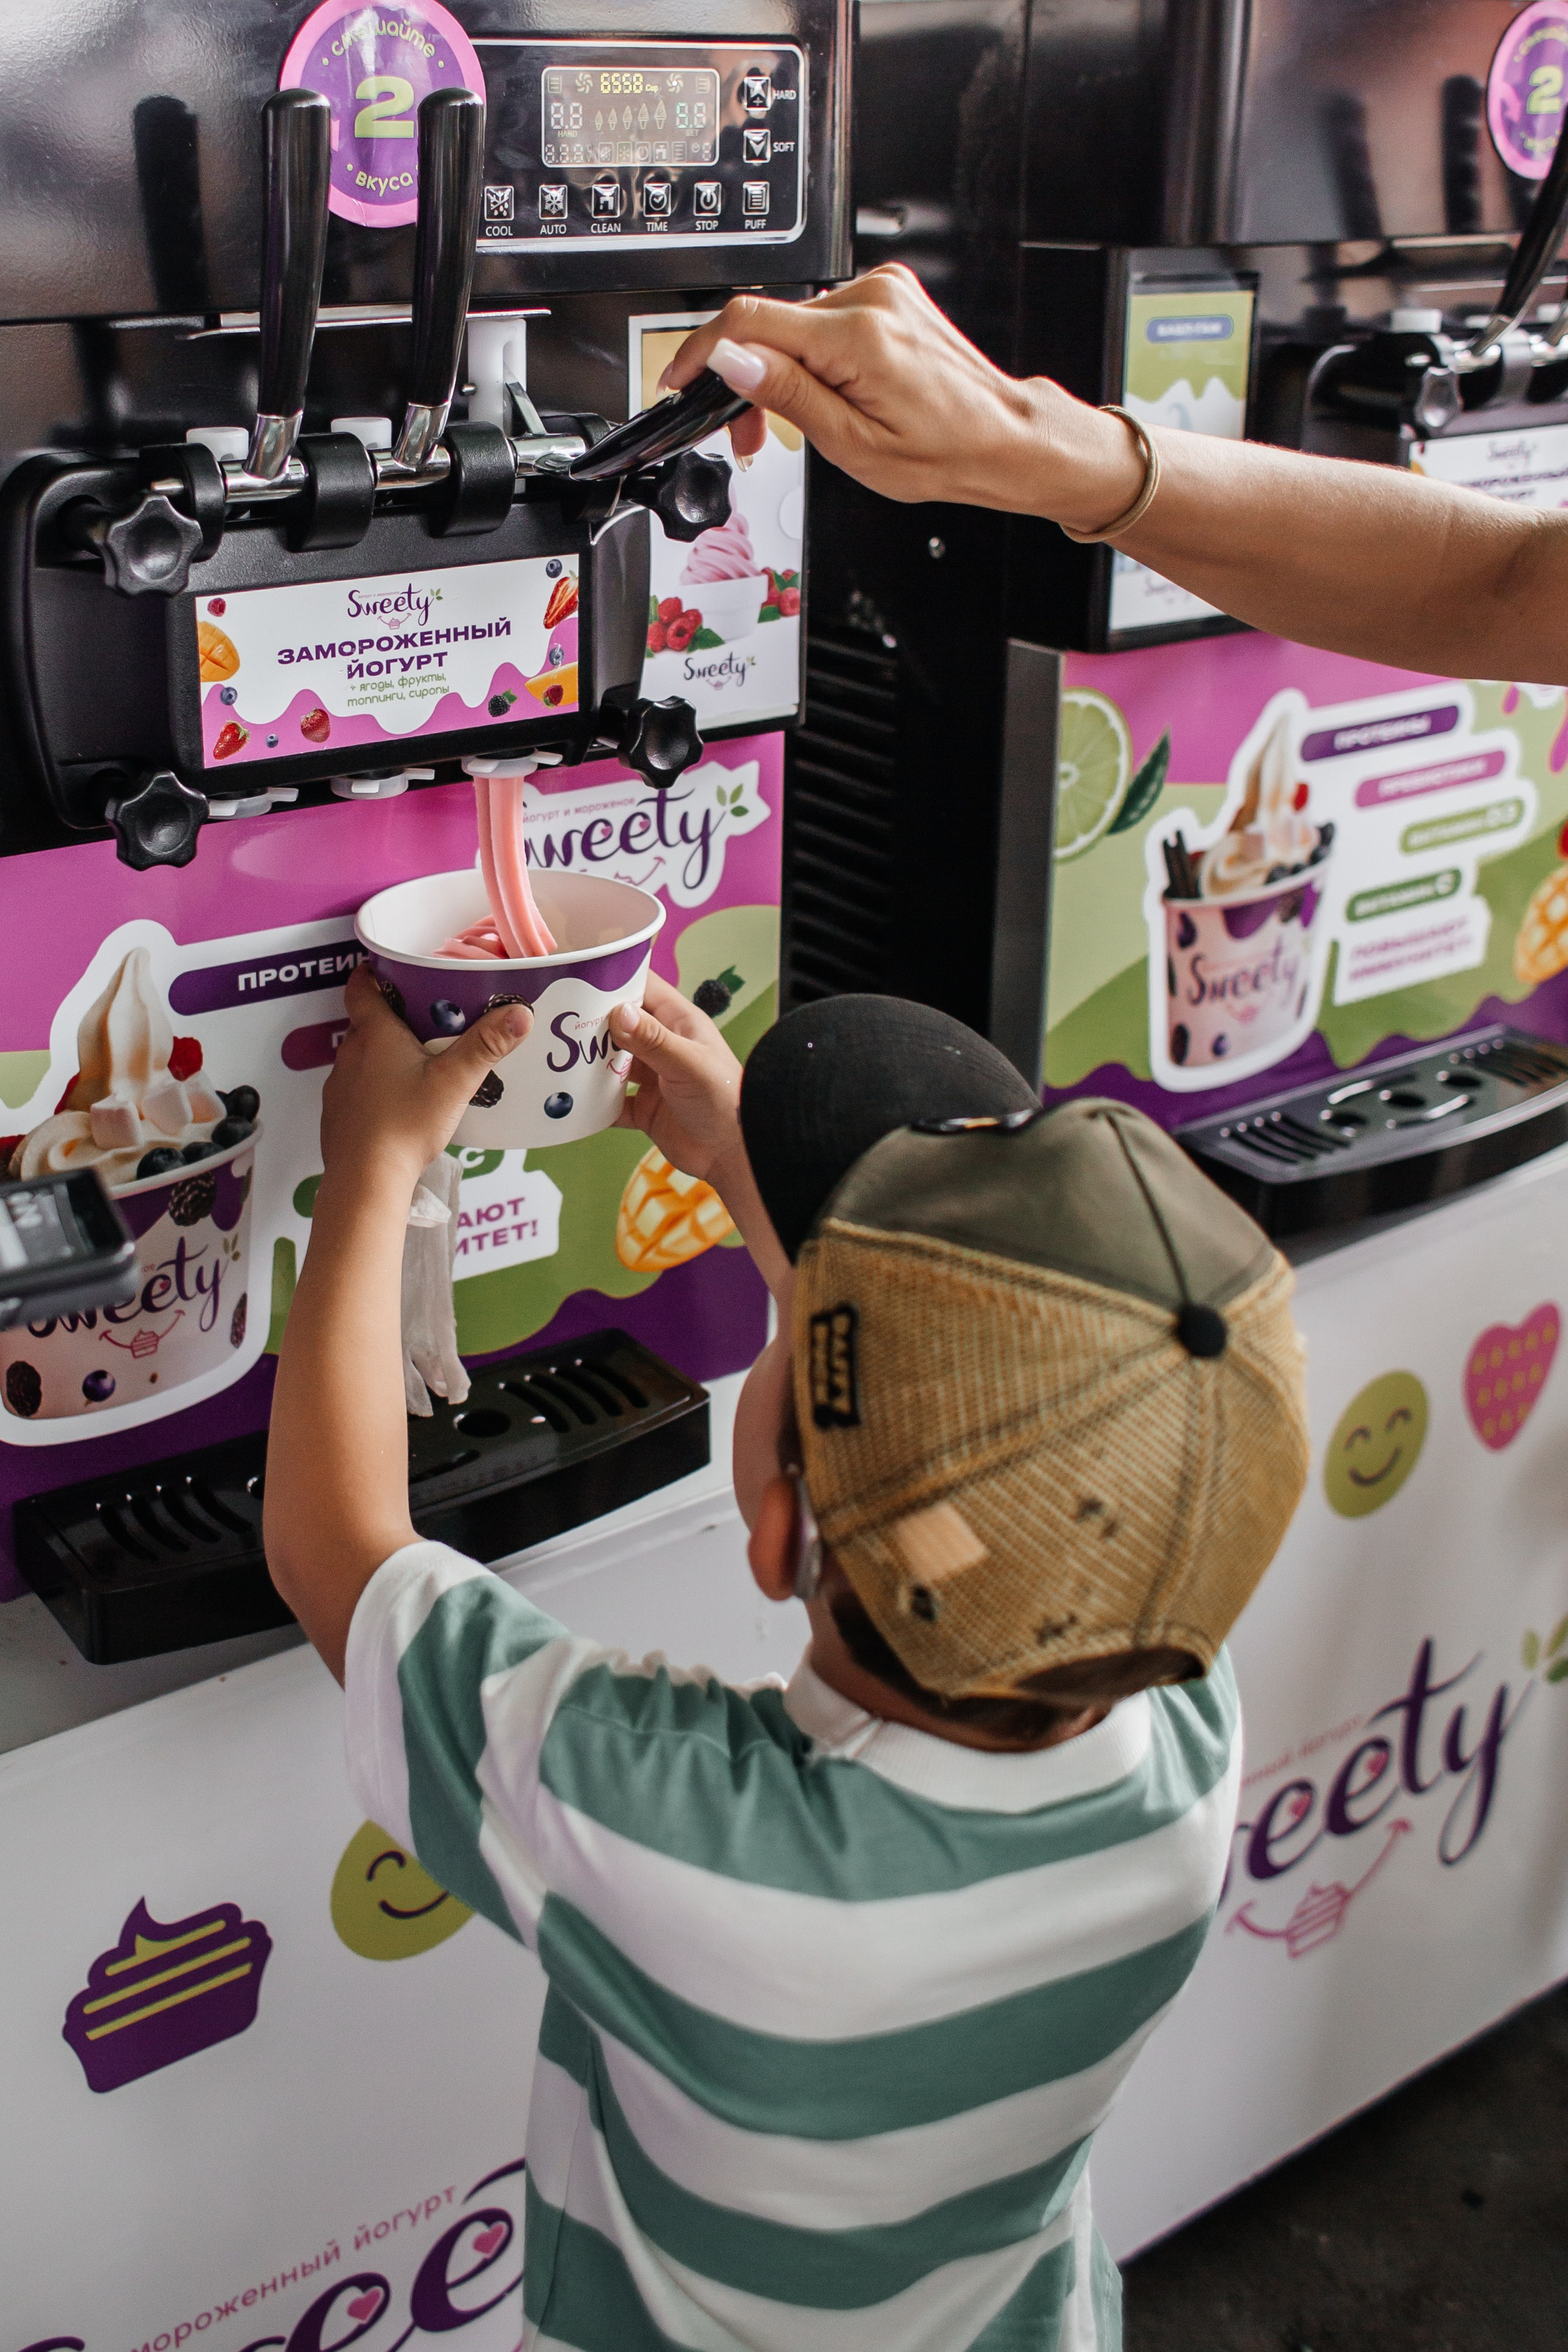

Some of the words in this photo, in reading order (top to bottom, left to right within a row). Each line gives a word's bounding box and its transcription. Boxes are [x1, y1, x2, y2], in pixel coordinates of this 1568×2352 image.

[774, 90, 796, 100] HARD
[1527, 66, 1563, 114] 2
[354, 75, 415, 138] 2
[773, 141, 795, 152] SOFT
[355, 171, 413, 197] вкуса
[485, 225, 513, 236] COOL
[540, 224, 567, 235] AUTO
[590, 222, 621, 234] CLEAN
[646, 221, 668, 232] TIME
[695, 220, 718, 231] STOP
[744, 218, 766, 230] PUFF
[347, 583, 434, 626] Sweety
[277, 617, 511, 665] ЗАМОРОЖЕННЫЙ
[347, 652, 448, 679] ЙОГУРТ
[684, 651, 746, 687] Sweety
[360, 680, 394, 692] ягоды,
[398, 673, 447, 688] фрукты,
[347, 692, 406, 707] топпинги,
[409, 686, 450, 699] сиропы
[575, 797, 635, 814] мороженое
[524, 788, 726, 889] weety
[353, 2185, 457, 2252] йогурт
